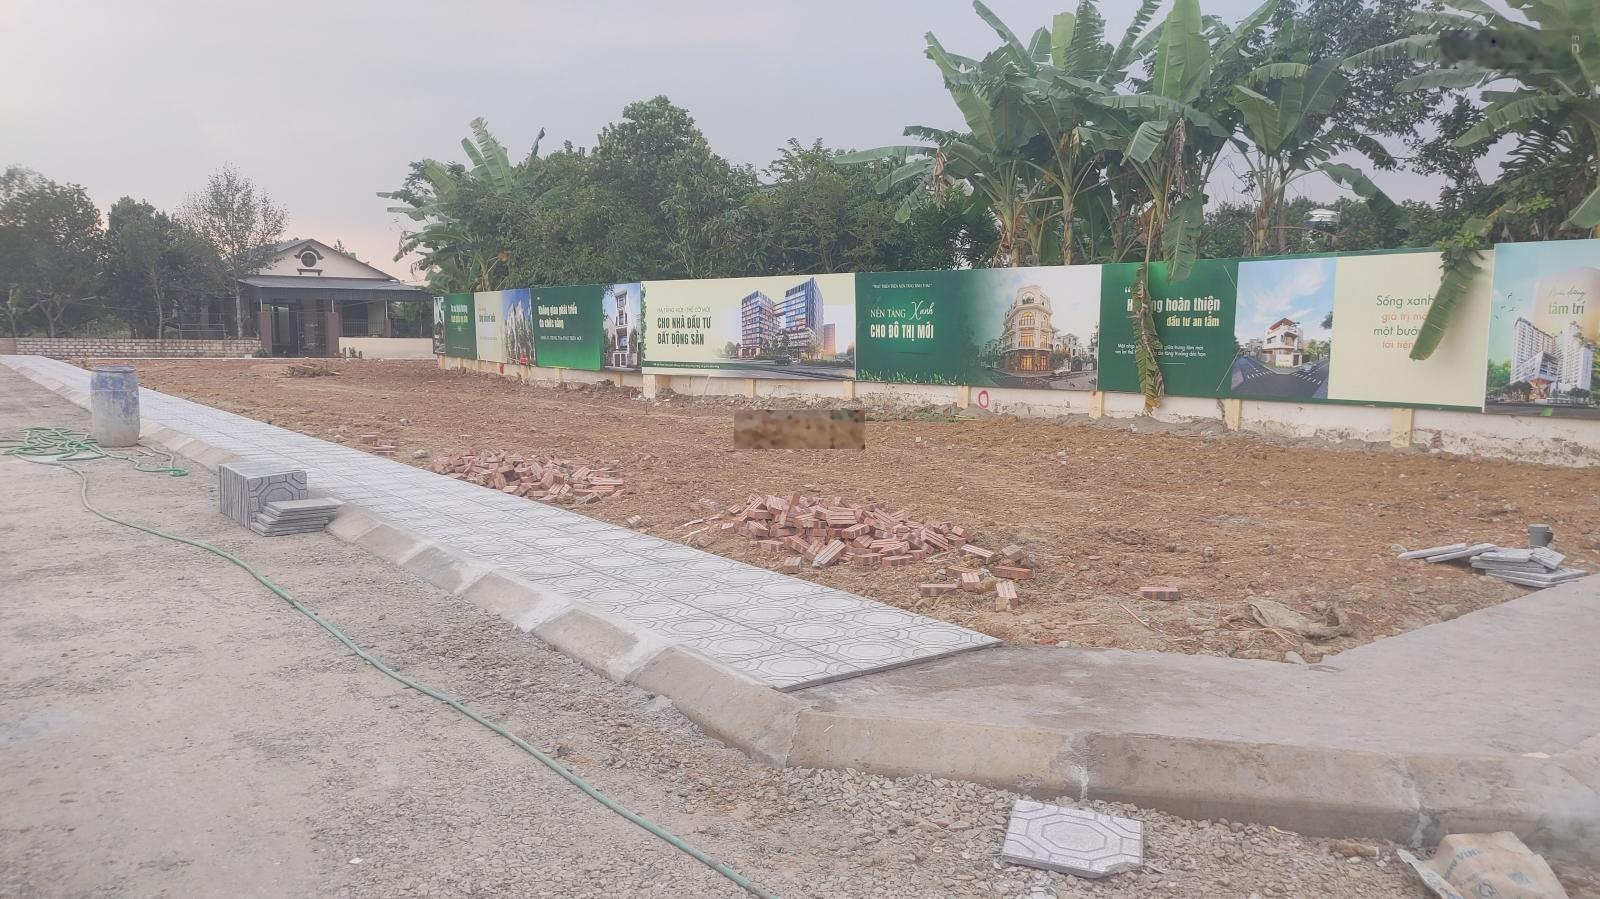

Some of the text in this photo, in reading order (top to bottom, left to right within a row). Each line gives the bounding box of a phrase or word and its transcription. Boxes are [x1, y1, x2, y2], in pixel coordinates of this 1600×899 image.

[870, 305, 885, 318] NỀN
[909, 299, 935, 321] Xanh
[1165, 297, 1190, 312] hoàn
[1194, 295, 1221, 314] thiện
[1375, 294, 1434, 309] Sống xanh
[657, 317, 670, 329] CHO
[672, 314, 685, 329] NHÀ
[702, 315, 712, 329] TƯ
[1166, 315, 1220, 327] đầu tư an tâm
[657, 329, 704, 348] BẤT ĐỘNG SẢN
[870, 320, 934, 342] CHO ĐÔ THỊ MỚI
[1373, 324, 1418, 338] một bướ
